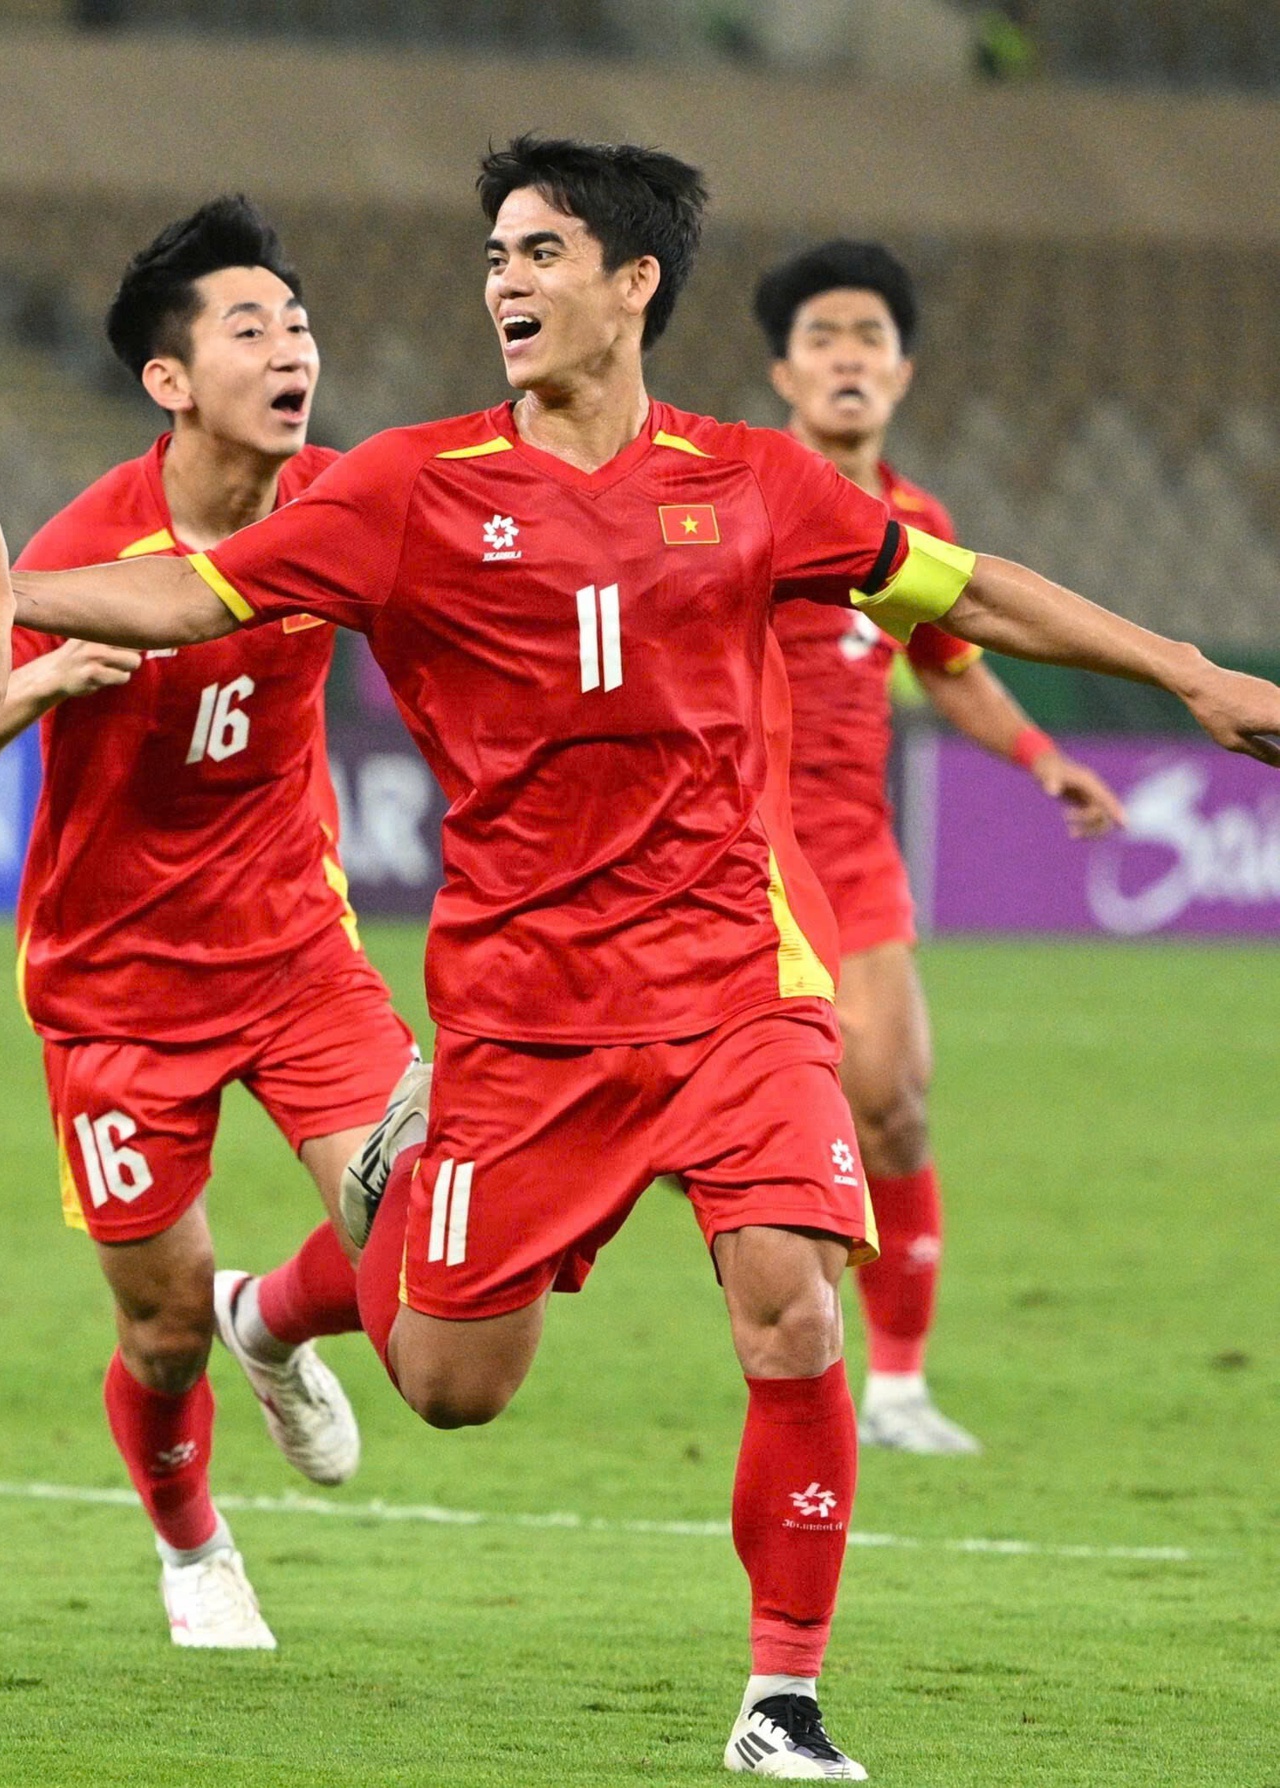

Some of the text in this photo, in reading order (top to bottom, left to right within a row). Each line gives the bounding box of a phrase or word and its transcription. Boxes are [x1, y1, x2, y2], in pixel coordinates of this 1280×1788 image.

[576, 583, 623, 692] 11
[185, 674, 255, 765] 16
[73, 1111, 153, 1208] 16
[427, 1158, 475, 1266] 11
